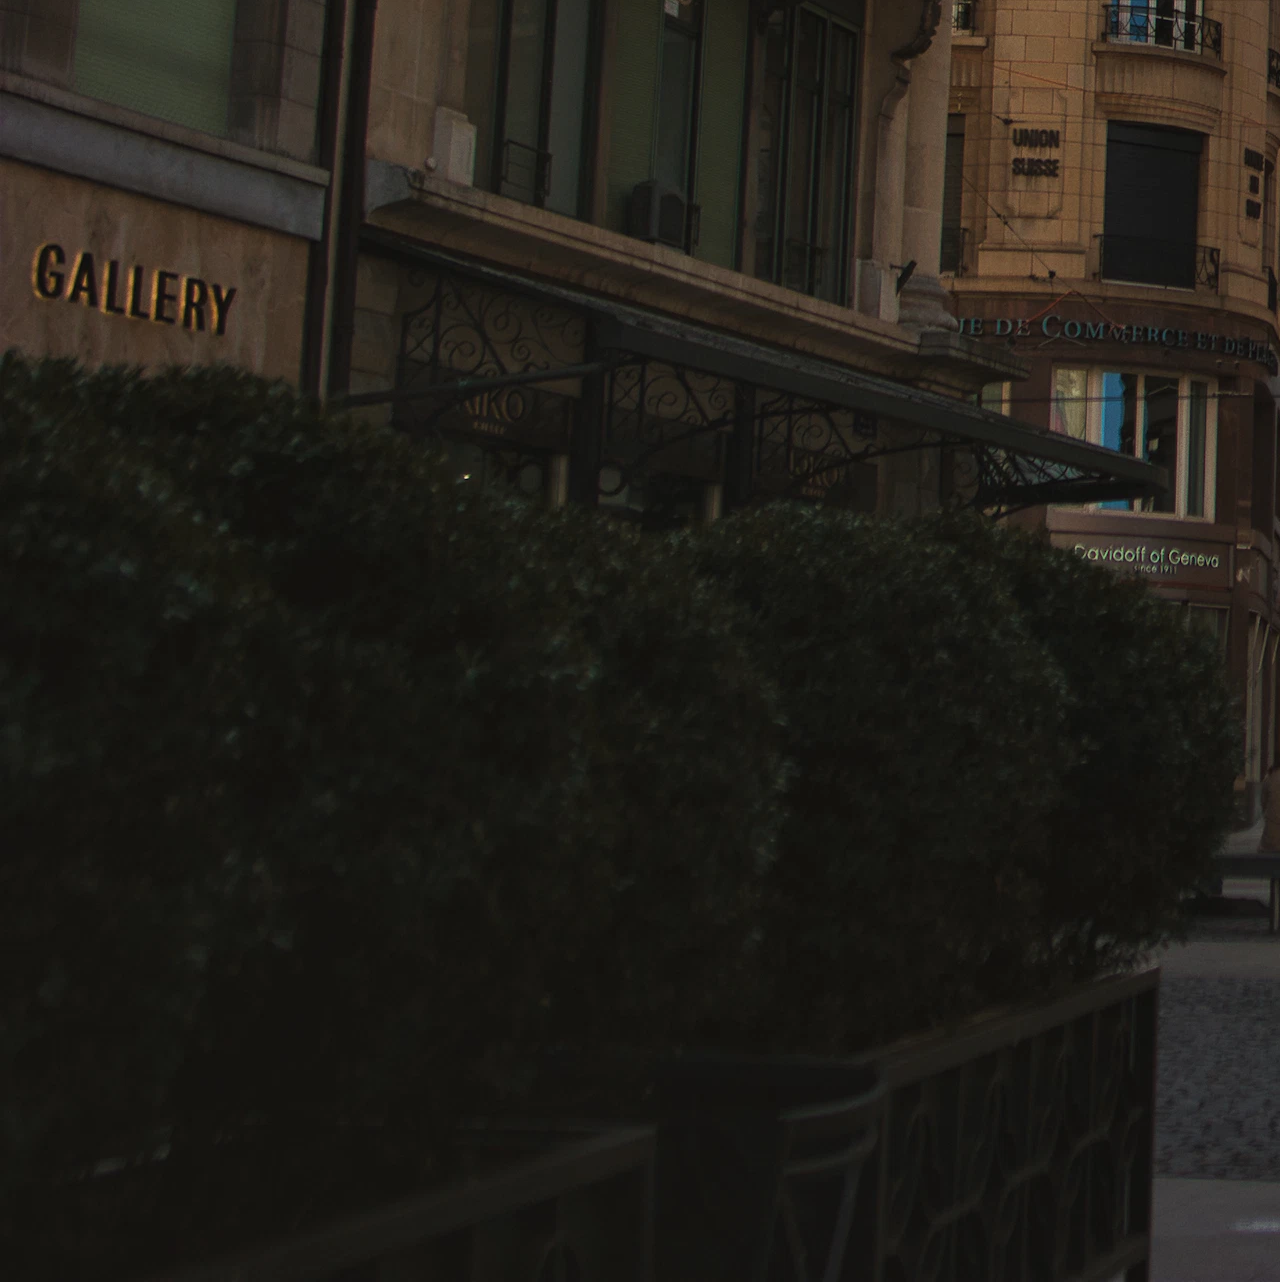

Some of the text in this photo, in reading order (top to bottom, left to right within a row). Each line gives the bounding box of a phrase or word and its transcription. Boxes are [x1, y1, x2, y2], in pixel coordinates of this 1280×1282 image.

[1012, 128, 1060, 149] UNION
[1012, 157, 1060, 178] SUISSE
[33, 241, 238, 337] GALLERY
[994, 317, 1031, 337] DE
[1196, 332, 1220, 351] ET
[1223, 336, 1245, 356] DE
[1150, 546, 1166, 564] of
[1168, 548, 1220, 568] Geneva
[1134, 564, 1178, 575] since 1911
